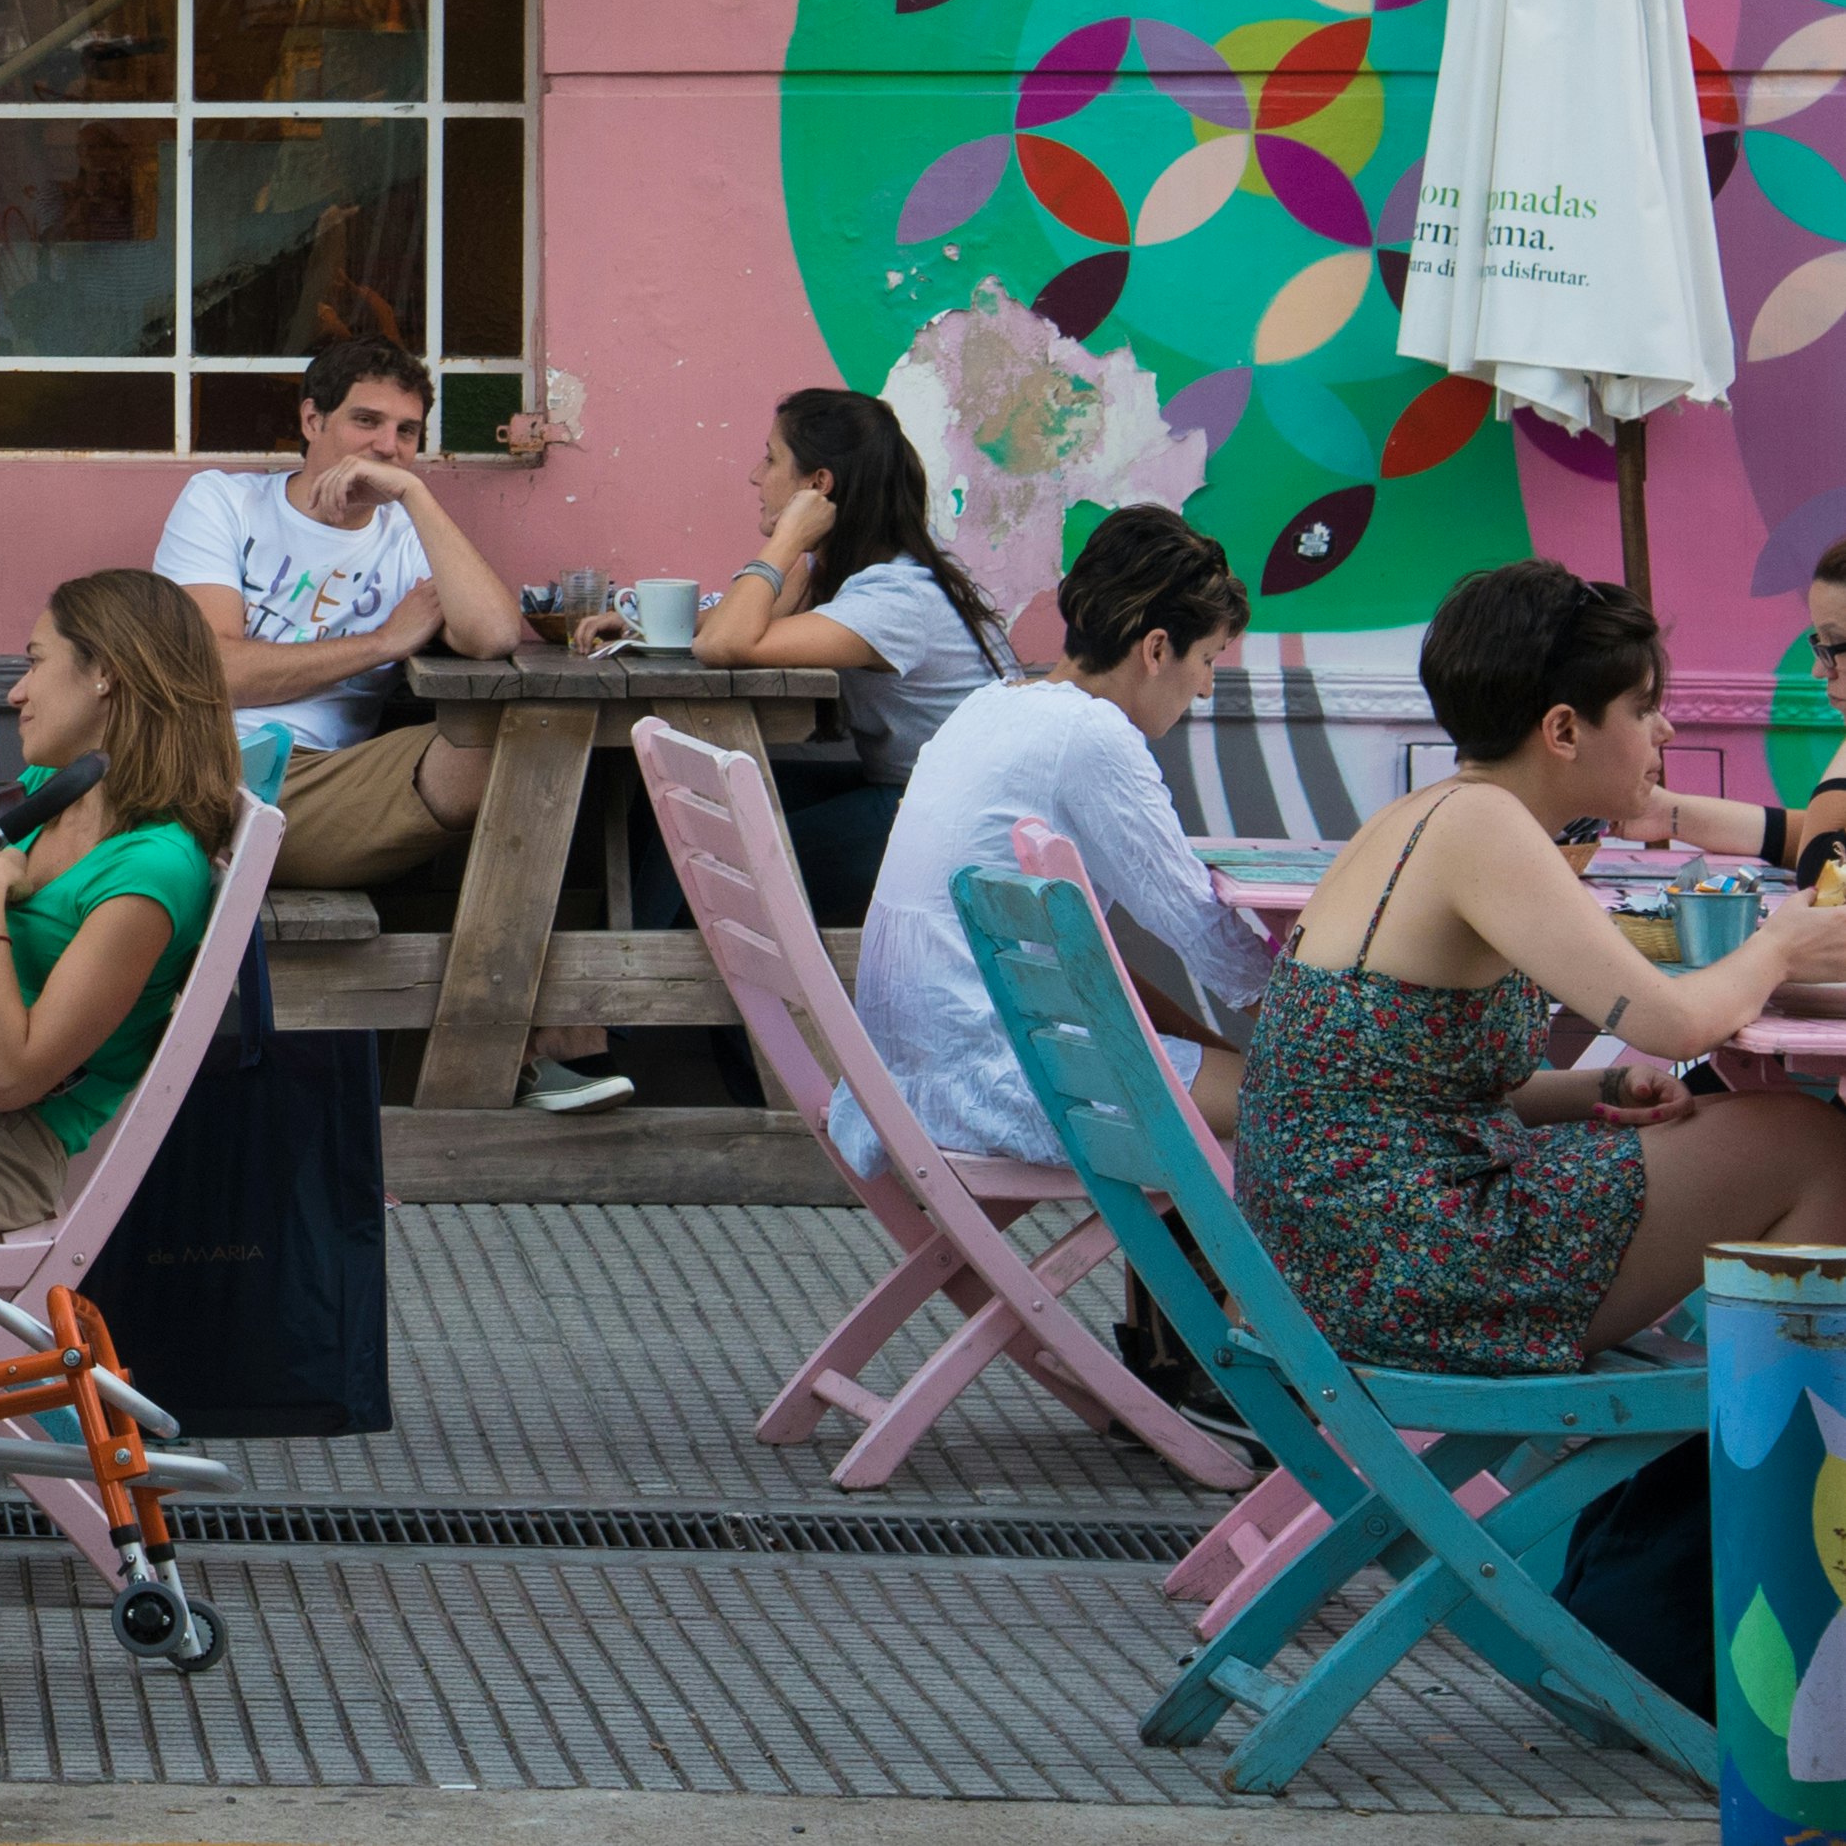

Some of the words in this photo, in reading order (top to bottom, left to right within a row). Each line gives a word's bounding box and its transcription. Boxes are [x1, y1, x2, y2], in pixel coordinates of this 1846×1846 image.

[1501, 259, 1590, 287] disfrutar.
[147, 1247, 175, 1264] de
[181, 1244, 265, 1263] MARIA
